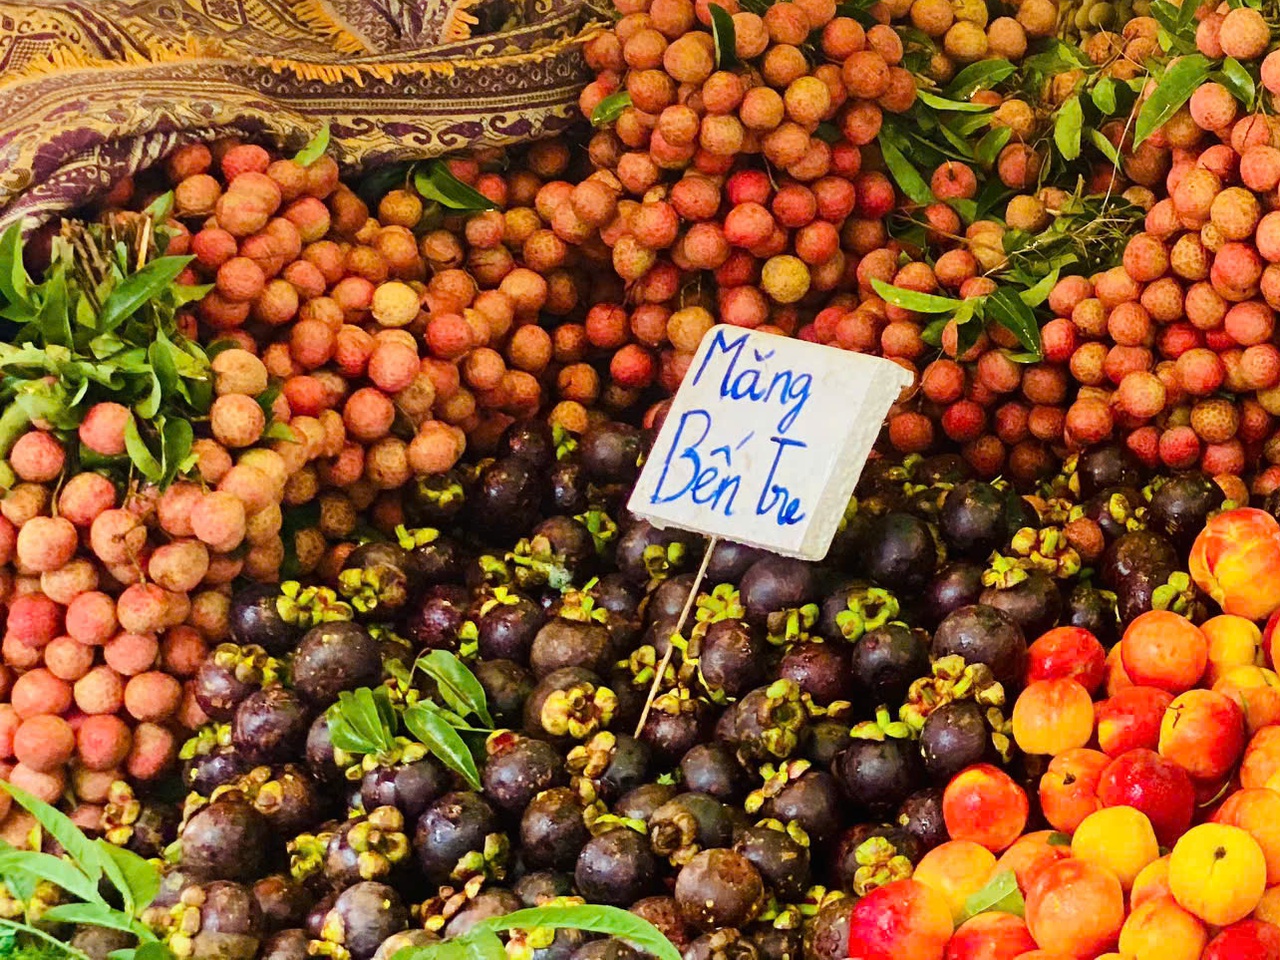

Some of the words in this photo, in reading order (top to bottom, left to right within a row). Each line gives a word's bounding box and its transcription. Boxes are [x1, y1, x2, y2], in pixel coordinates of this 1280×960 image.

[691, 329, 813, 435] Măng
[649, 408, 755, 516] Bến
[756, 436, 808, 526] Tre
